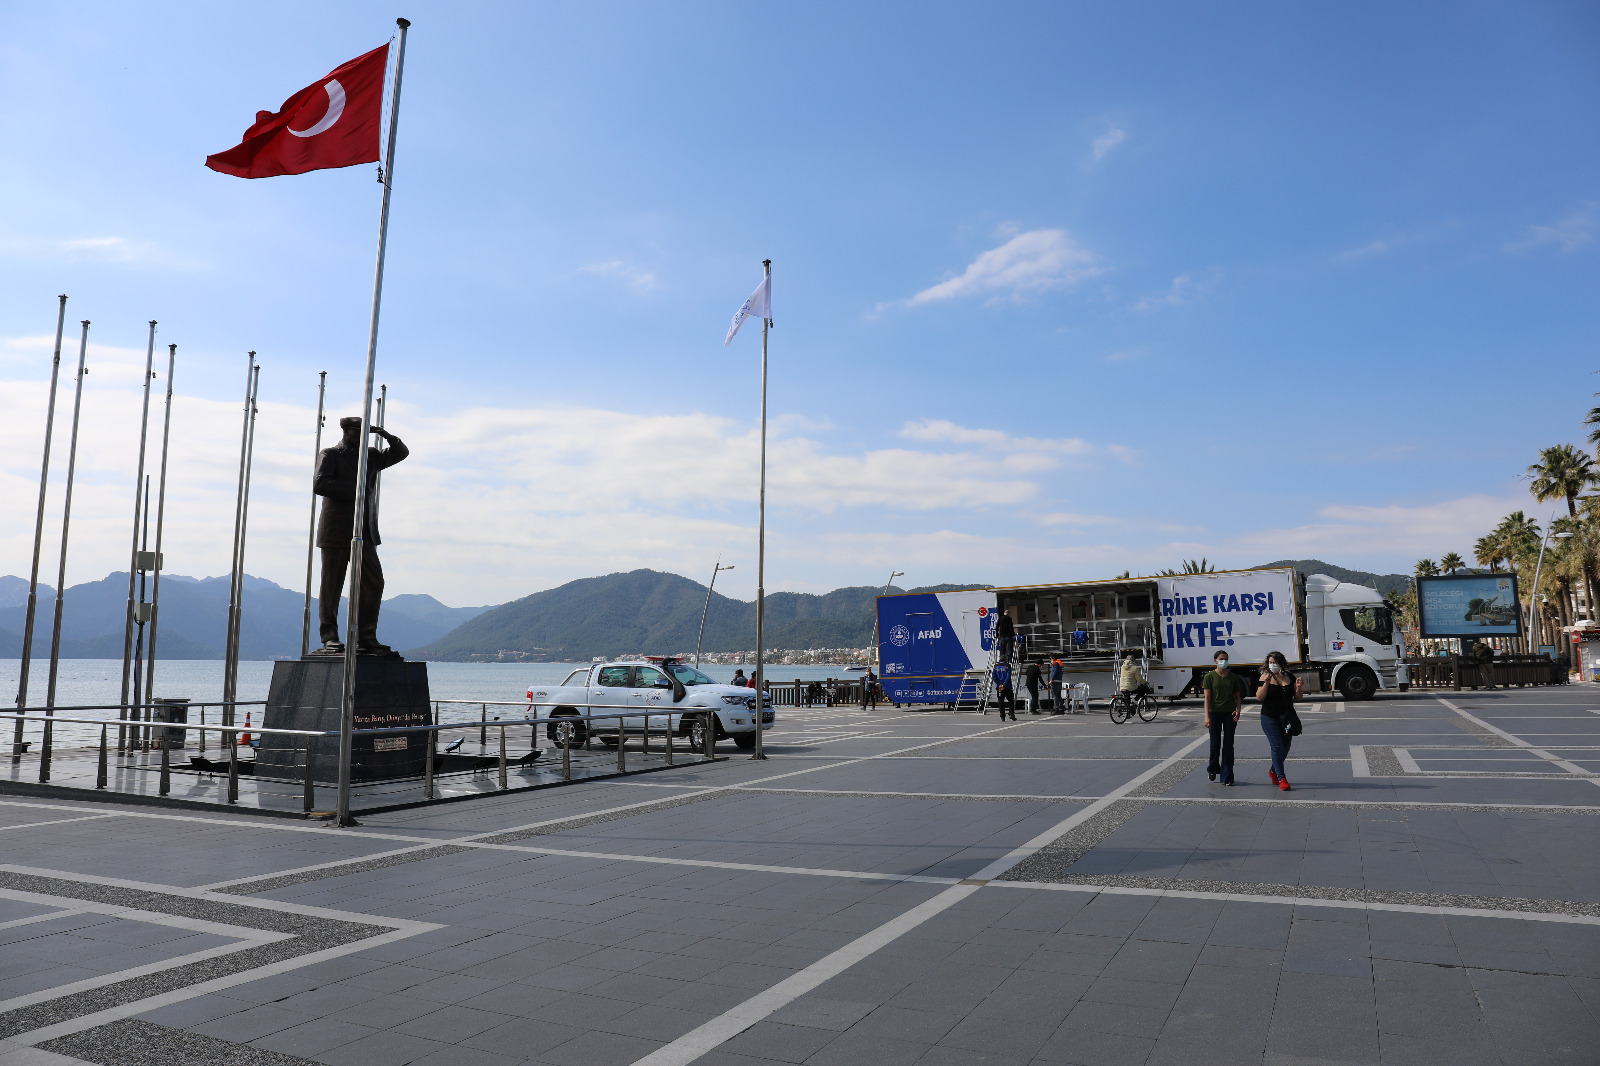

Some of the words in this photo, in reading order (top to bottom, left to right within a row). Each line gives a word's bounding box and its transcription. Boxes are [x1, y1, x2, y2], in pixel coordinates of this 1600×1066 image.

[1159, 592, 1208, 616] RİNE
[1213, 591, 1274, 615] KARŞI
[917, 629, 942, 640] AFAD
